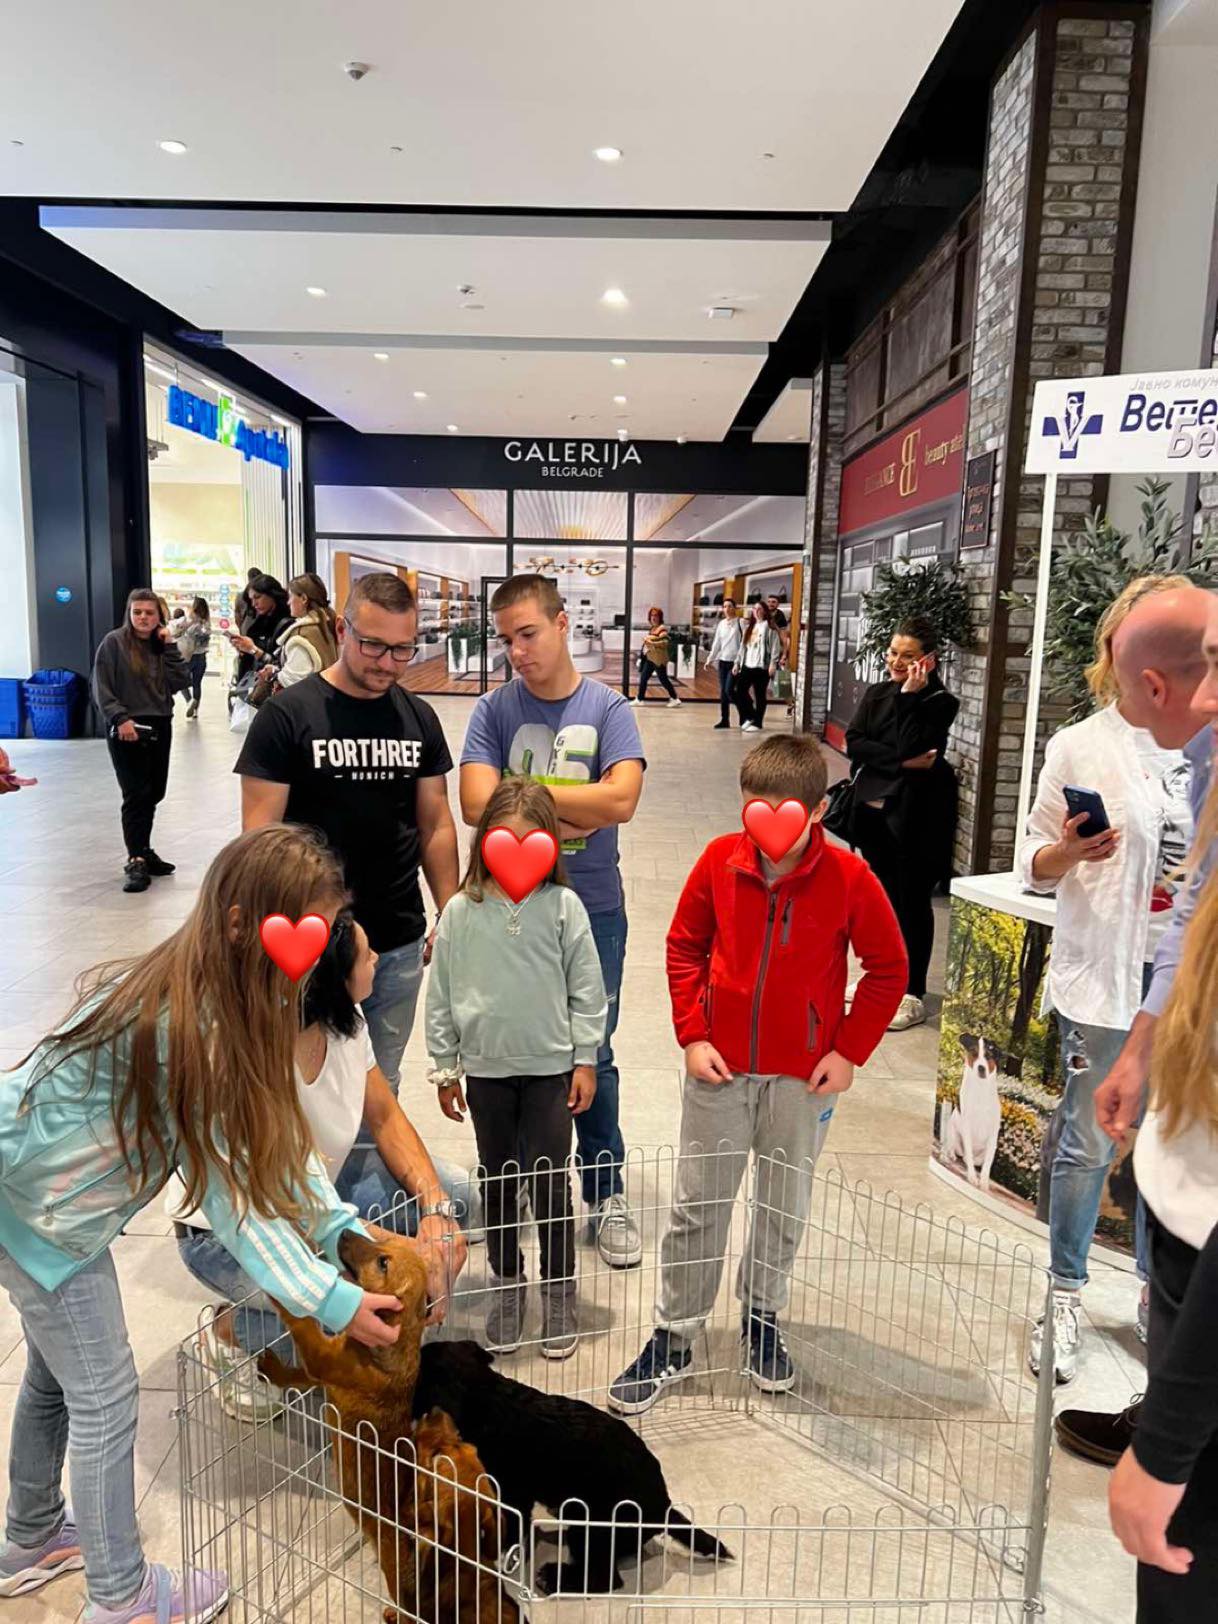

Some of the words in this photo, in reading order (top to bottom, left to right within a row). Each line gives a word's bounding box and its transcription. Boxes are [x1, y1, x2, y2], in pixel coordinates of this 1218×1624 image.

[1167, 417, 1218, 459] Бе
[504, 441, 643, 470] GALERIJA
[541, 466, 604, 478] BELGRADE
[312, 738, 422, 768] FORTHREE
